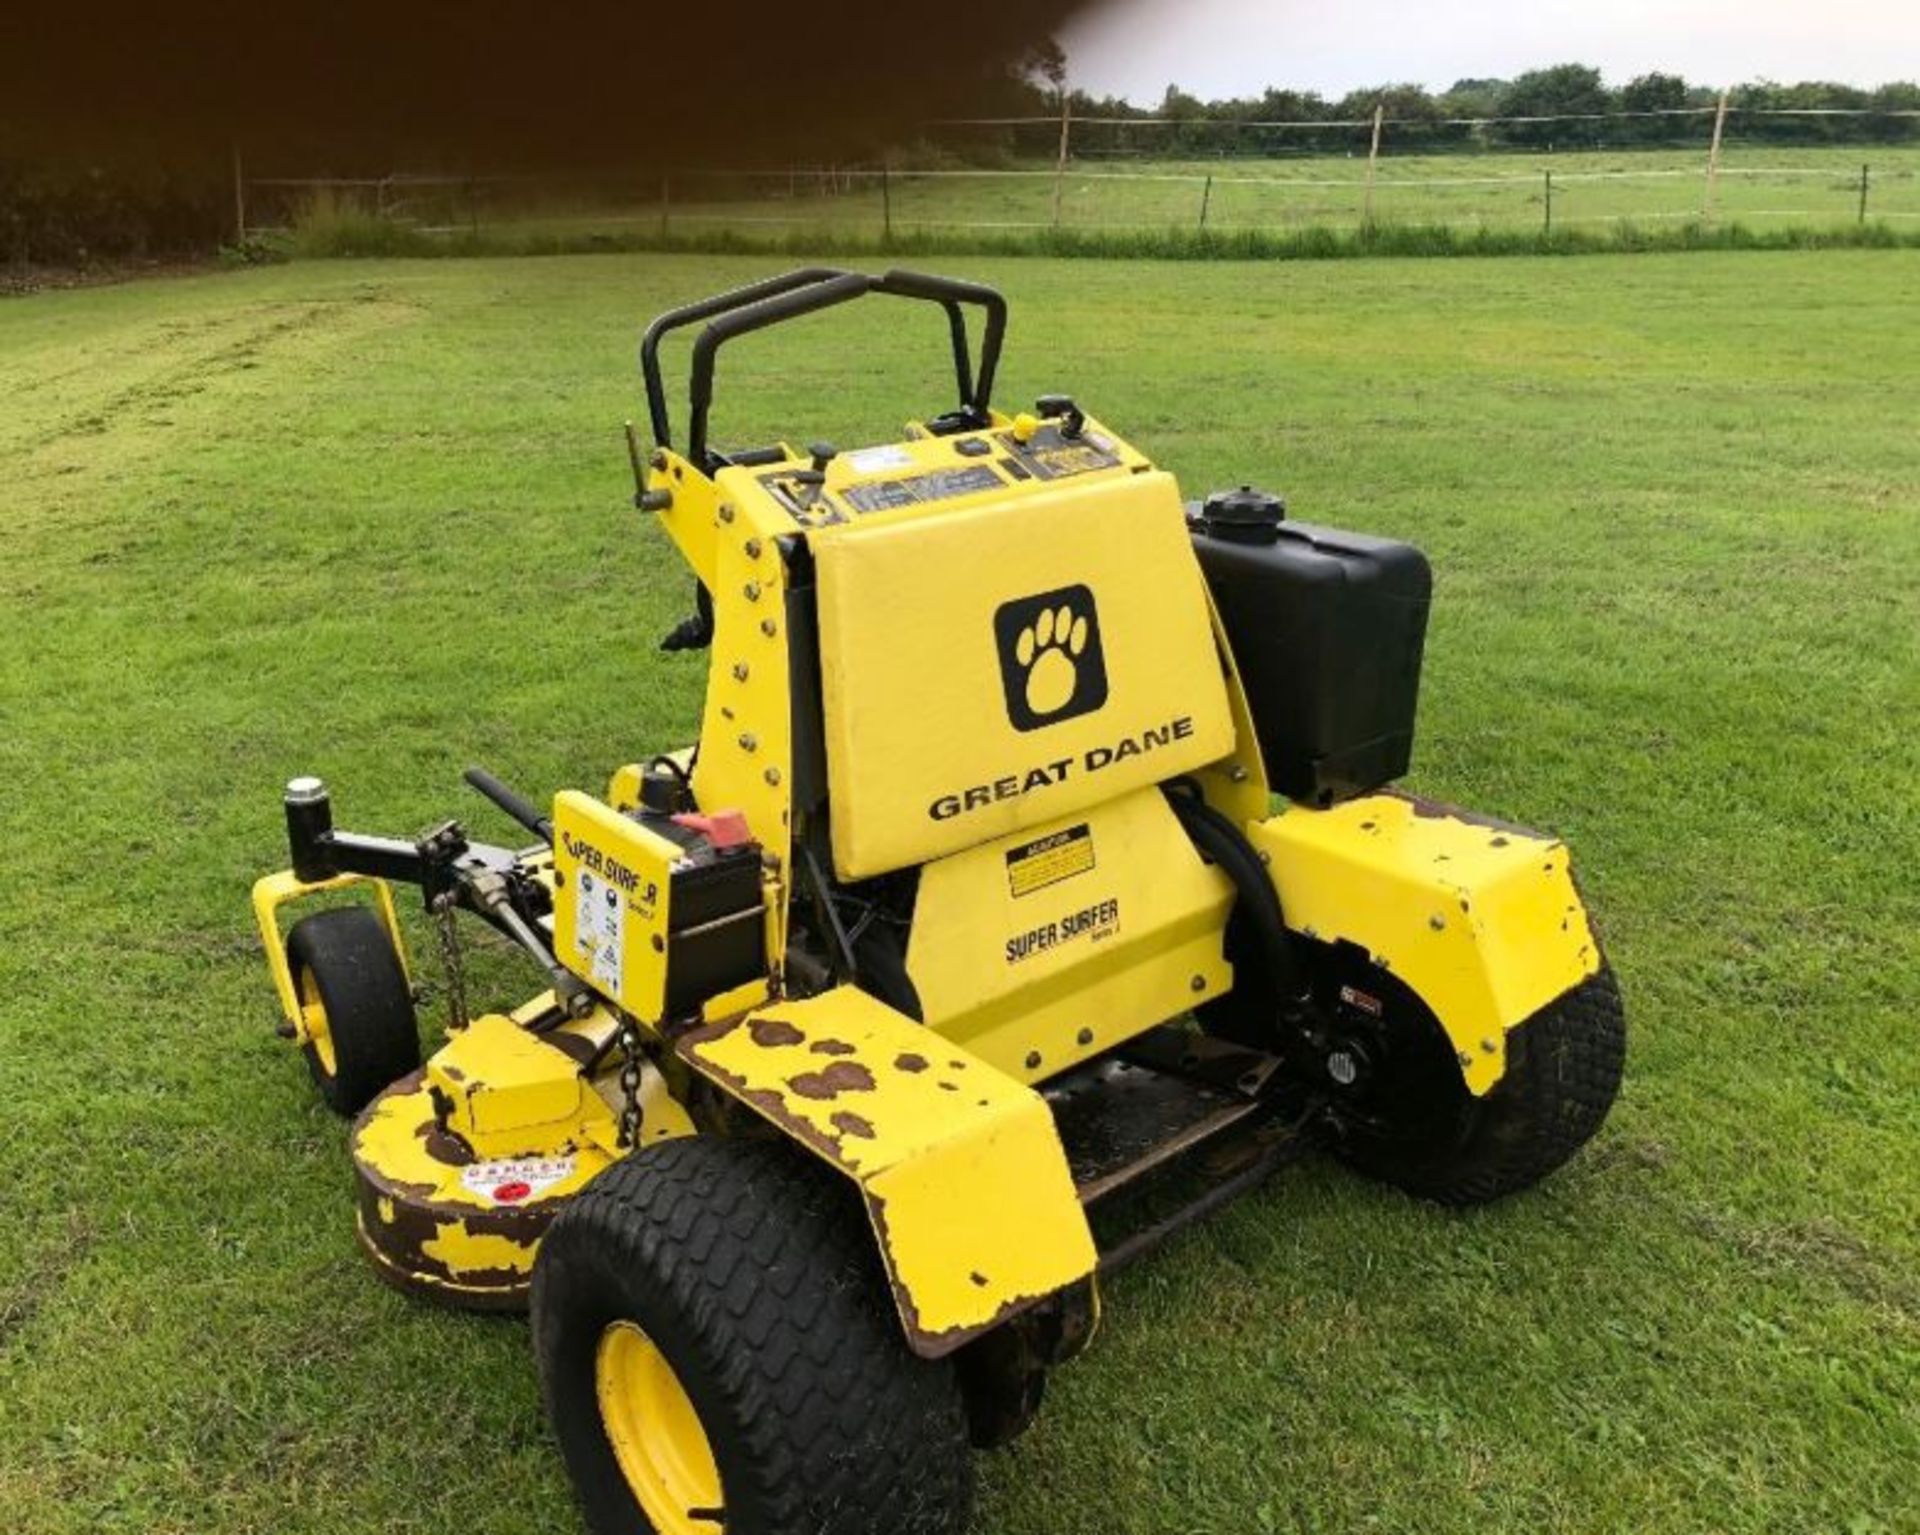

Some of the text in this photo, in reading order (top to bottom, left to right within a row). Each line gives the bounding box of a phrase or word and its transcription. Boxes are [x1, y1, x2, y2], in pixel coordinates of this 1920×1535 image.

[928, 717, 1194, 821] GREAT DANE
[604, 856, 657, 906] SURFR
[1005, 898, 1119, 962] SUPER SURFER
